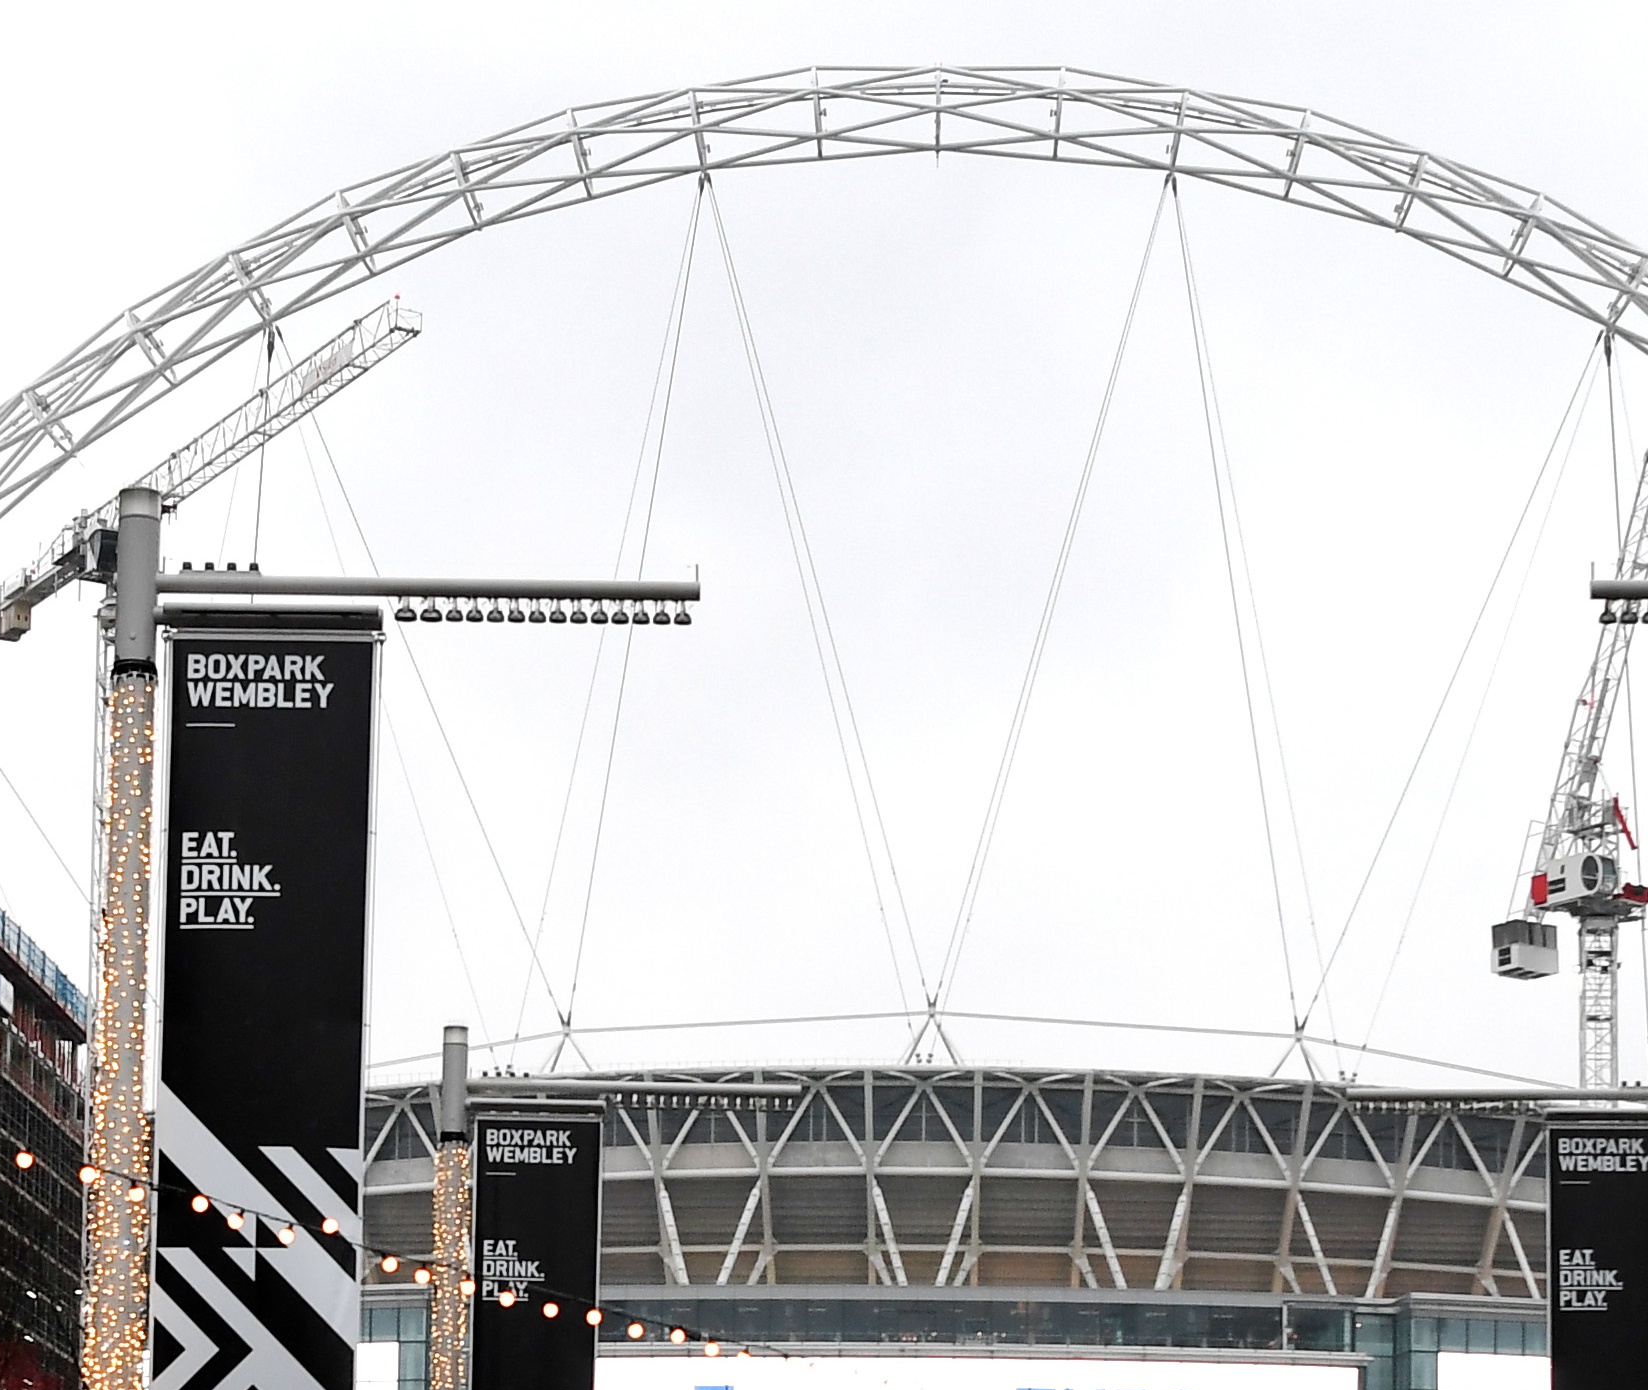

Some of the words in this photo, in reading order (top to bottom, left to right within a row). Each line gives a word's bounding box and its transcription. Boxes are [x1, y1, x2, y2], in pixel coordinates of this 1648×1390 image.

[187, 653, 326, 681] BOXPARK
[187, 682, 335, 708] WEMBLEY
[181, 831, 238, 858] EAT.
[181, 864, 281, 891] DRINK.
[179, 897, 255, 924] PLAY.
[485, 1128, 572, 1147] BOXPARK
[1558, 1137, 1644, 1154] BOXPARK
[486, 1147, 577, 1165] WEMBLEY
[483, 1239, 518, 1257] EAT.
[1559, 1249, 1596, 1266] EAT.
[482, 1260, 545, 1277] DRINK.
[1559, 1270, 1624, 1286] DRINK.
[482, 1280, 529, 1298] PLAY.
[1559, 1290, 1608, 1307] PLAY.
